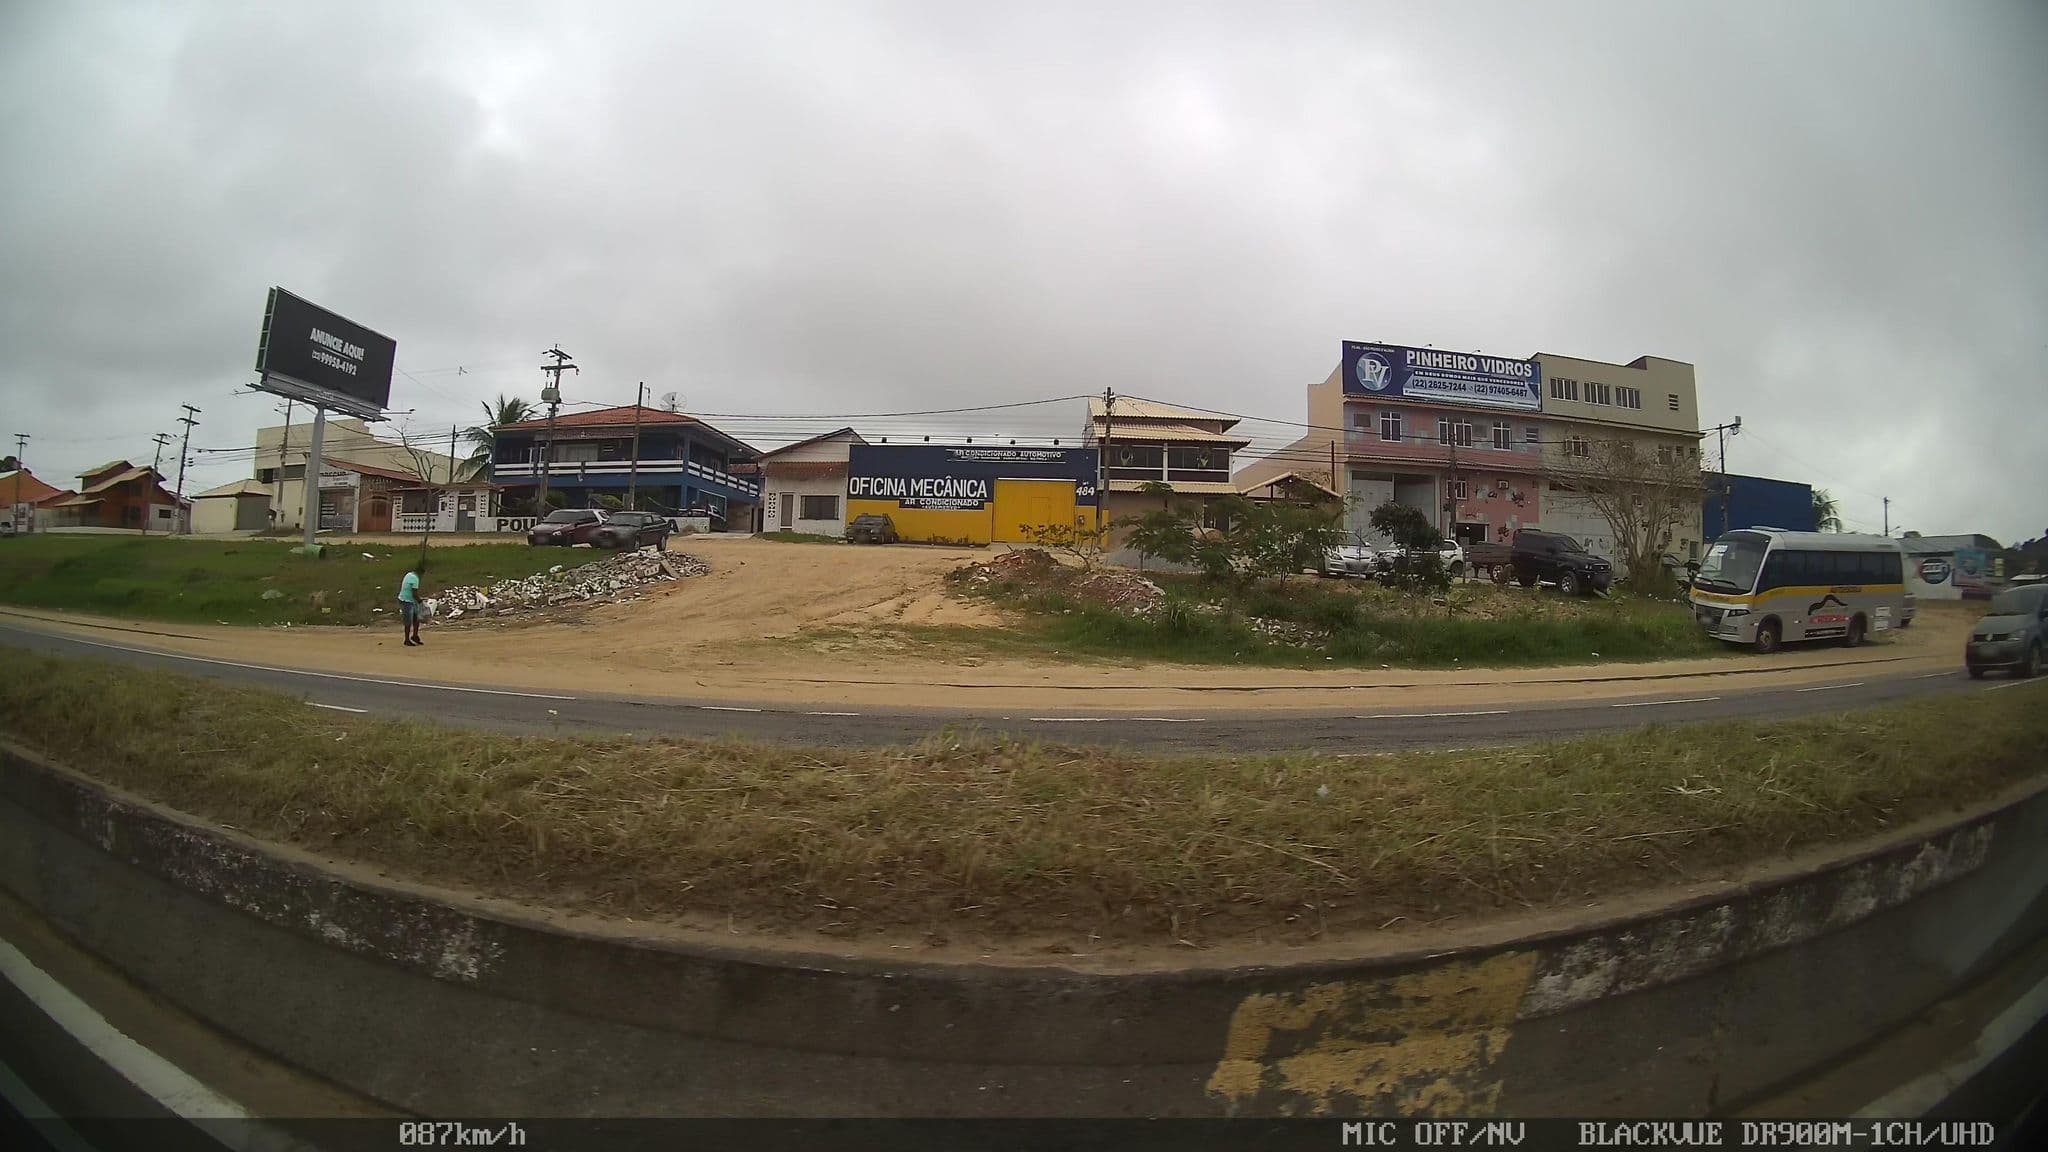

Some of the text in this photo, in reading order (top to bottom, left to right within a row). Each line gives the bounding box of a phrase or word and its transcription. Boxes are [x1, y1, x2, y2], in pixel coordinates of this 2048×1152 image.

[310, 328, 364, 361] ANUNCIE AQUI!
[1406, 350, 1532, 377] PINHEIRO VIDROS
[1412, 378, 1427, 389] (22)
[1474, 383, 1488, 395] (22)
[849, 475, 987, 498] OFICINA MECÂNICA
[1076, 486, 1095, 496] 484
[919, 498, 979, 506] CONDICIONADO
